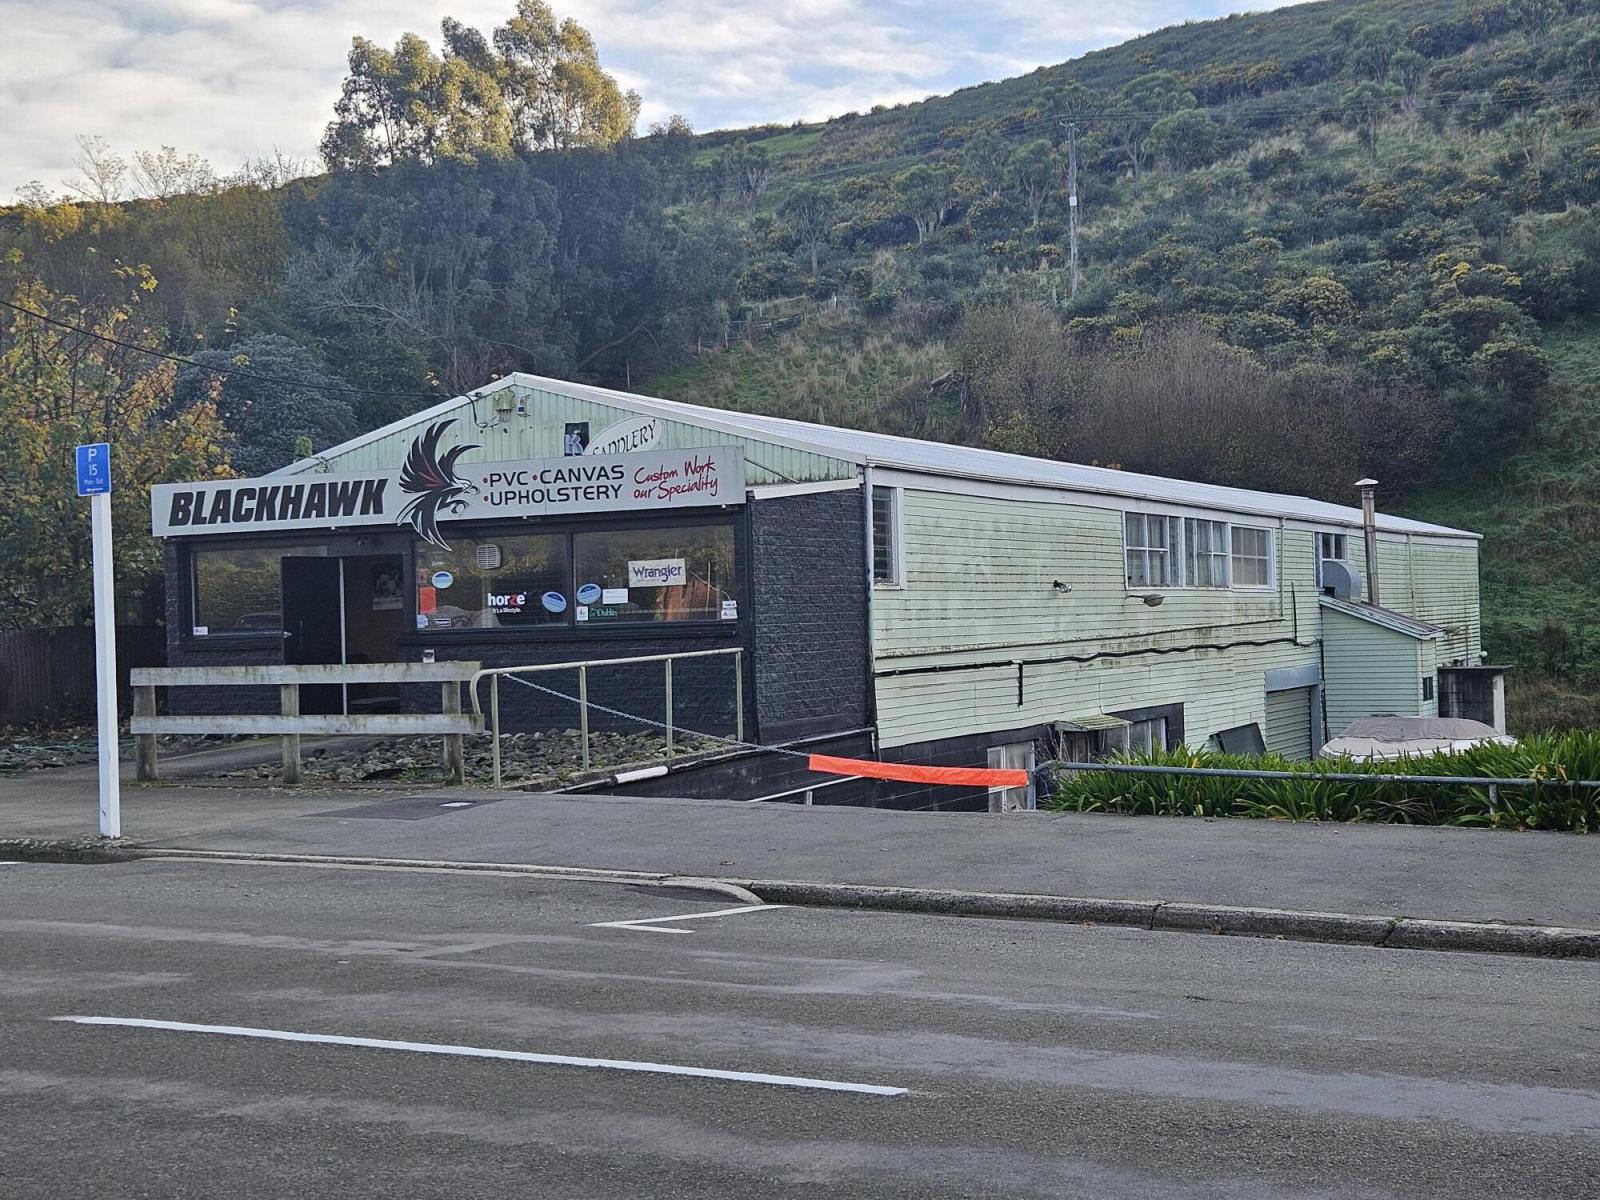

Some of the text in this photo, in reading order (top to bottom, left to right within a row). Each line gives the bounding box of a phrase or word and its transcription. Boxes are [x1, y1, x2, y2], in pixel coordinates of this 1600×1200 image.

[88, 448, 97, 462] P
[489, 465, 625, 487] PVC CANVAS
[634, 454, 716, 484] Custom Work
[490, 484, 623, 506] UPHOLSTERY
[634, 473, 718, 502] our Speciality
[168, 478, 389, 527] BLACKHAWK
[632, 565, 682, 582] Wrangler
[487, 592, 526, 607] horze
[597, 607, 617, 617] Dublin
